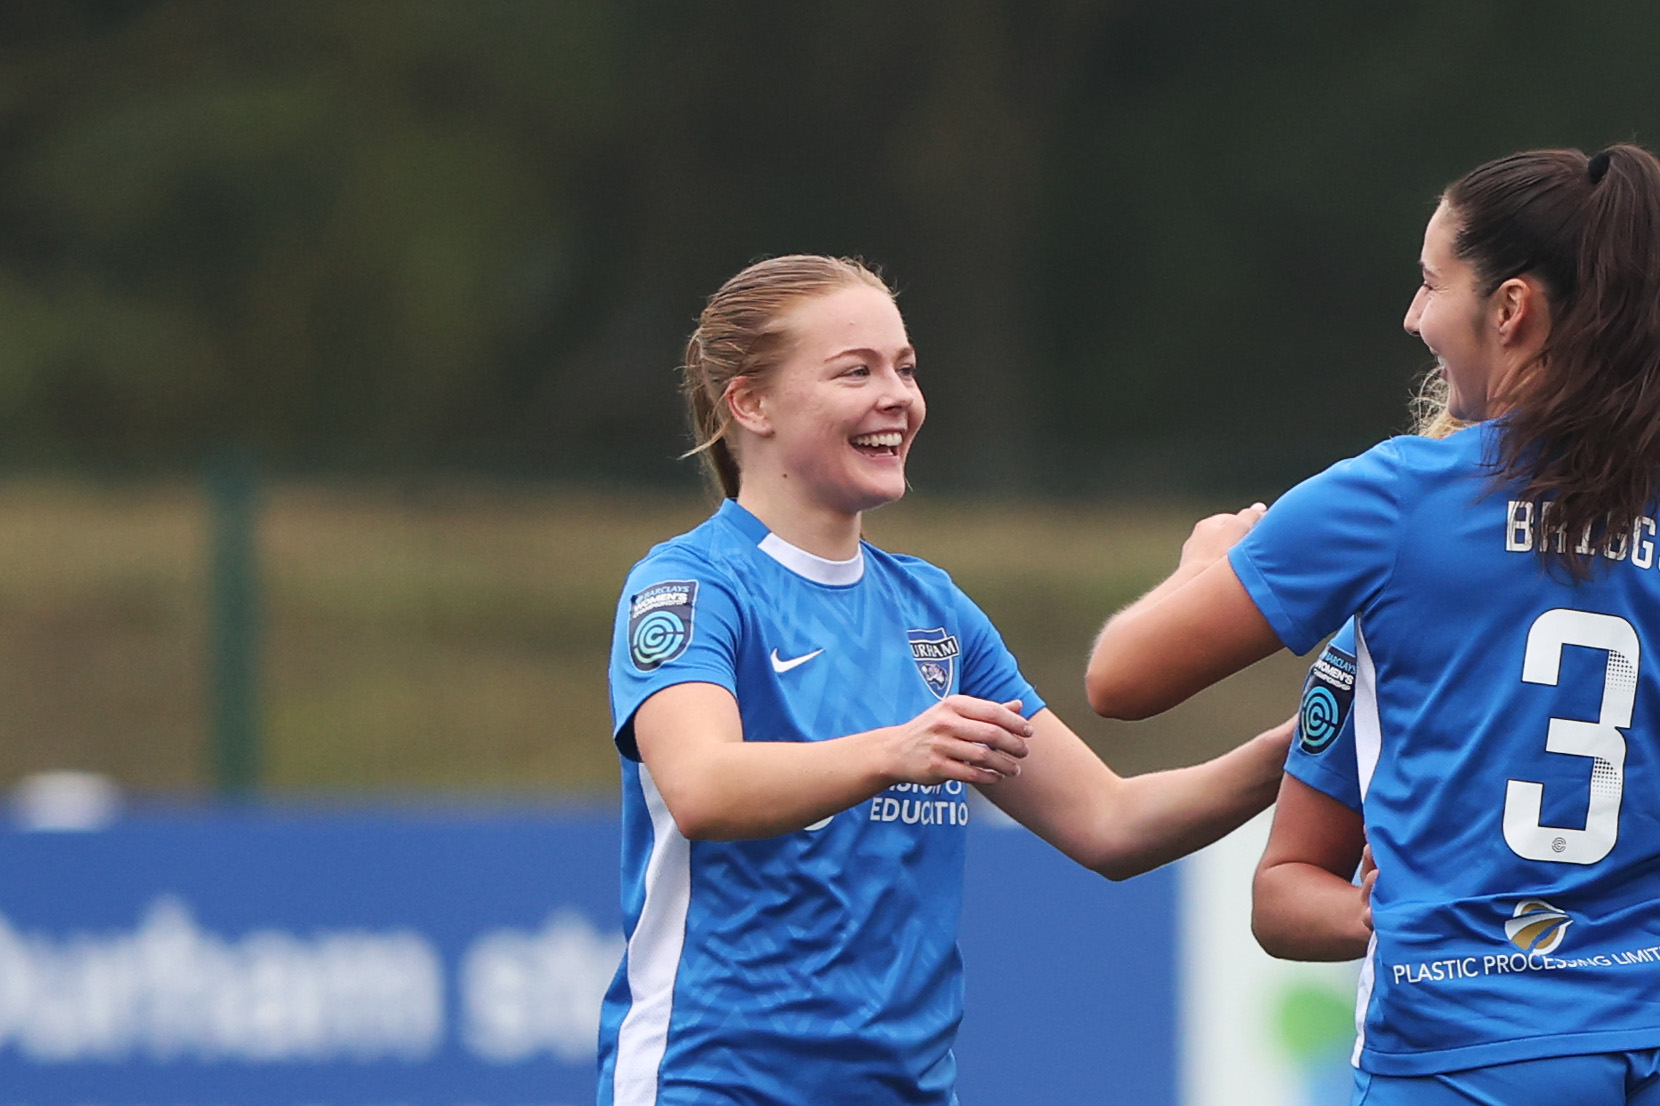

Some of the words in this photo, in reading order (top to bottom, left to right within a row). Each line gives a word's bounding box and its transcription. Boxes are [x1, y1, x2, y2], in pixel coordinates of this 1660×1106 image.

[912, 641, 956, 659] URHAM
[1502, 607, 1641, 865] 3
[1393, 956, 1479, 985] PLASTIC
